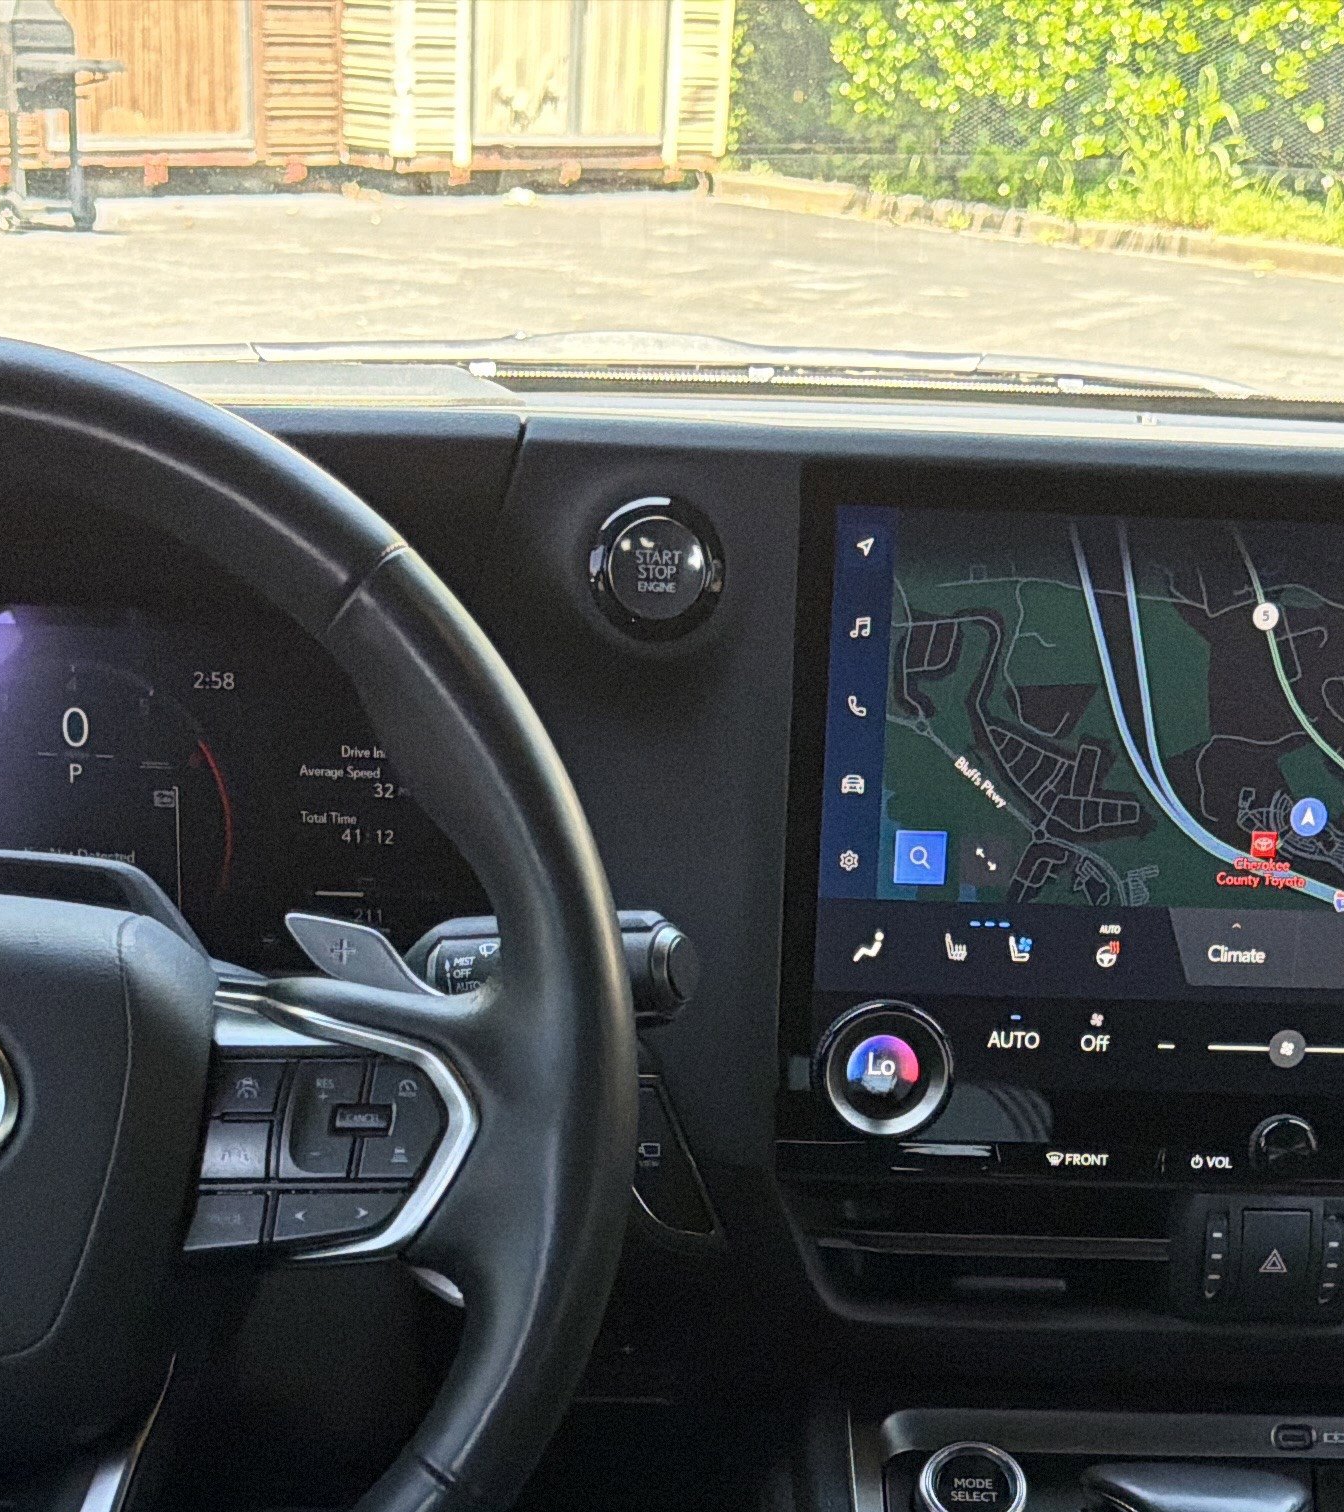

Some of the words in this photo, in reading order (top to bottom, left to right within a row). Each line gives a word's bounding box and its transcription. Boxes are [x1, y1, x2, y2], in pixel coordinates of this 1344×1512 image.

[635, 549, 682, 565] START
[638, 564, 677, 580] STOP
[638, 581, 677, 593] ENGINE
[1261, 610, 1271, 624] 5
[193, 671, 235, 691] 2:58
[62, 707, 90, 748] 0
[341, 745, 371, 759] Drive
[69, 763, 82, 784] P
[299, 764, 344, 781] Average
[346, 765, 381, 781] Speed
[954, 756, 982, 786] Bluffs
[980, 780, 1007, 808] Pkwy
[373, 783, 395, 799] 32
[300, 810, 328, 825] Total
[330, 811, 358, 825] Time
[1233, 857, 1291, 872] Cherokee
[1216, 871, 1261, 888] County
[1264, 873, 1306, 889] Toyota
[1098, 923, 1122, 934] AUTO
[453, 955, 476, 967] MIST
[1207, 945, 1266, 965] Climate
[452, 968, 473, 979] OFF
[987, 1030, 1041, 1050] AUTO
[1080, 1033, 1110, 1053] Off
[867, 1052, 896, 1077] Lo
[316, 1078, 335, 1091] RES
[1064, 1152, 1109, 1168] FRONT
[1205, 1155, 1233, 1170] VOL
[953, 1477, 993, 1490] MODE
[950, 1490, 998, 1503] SELECT
